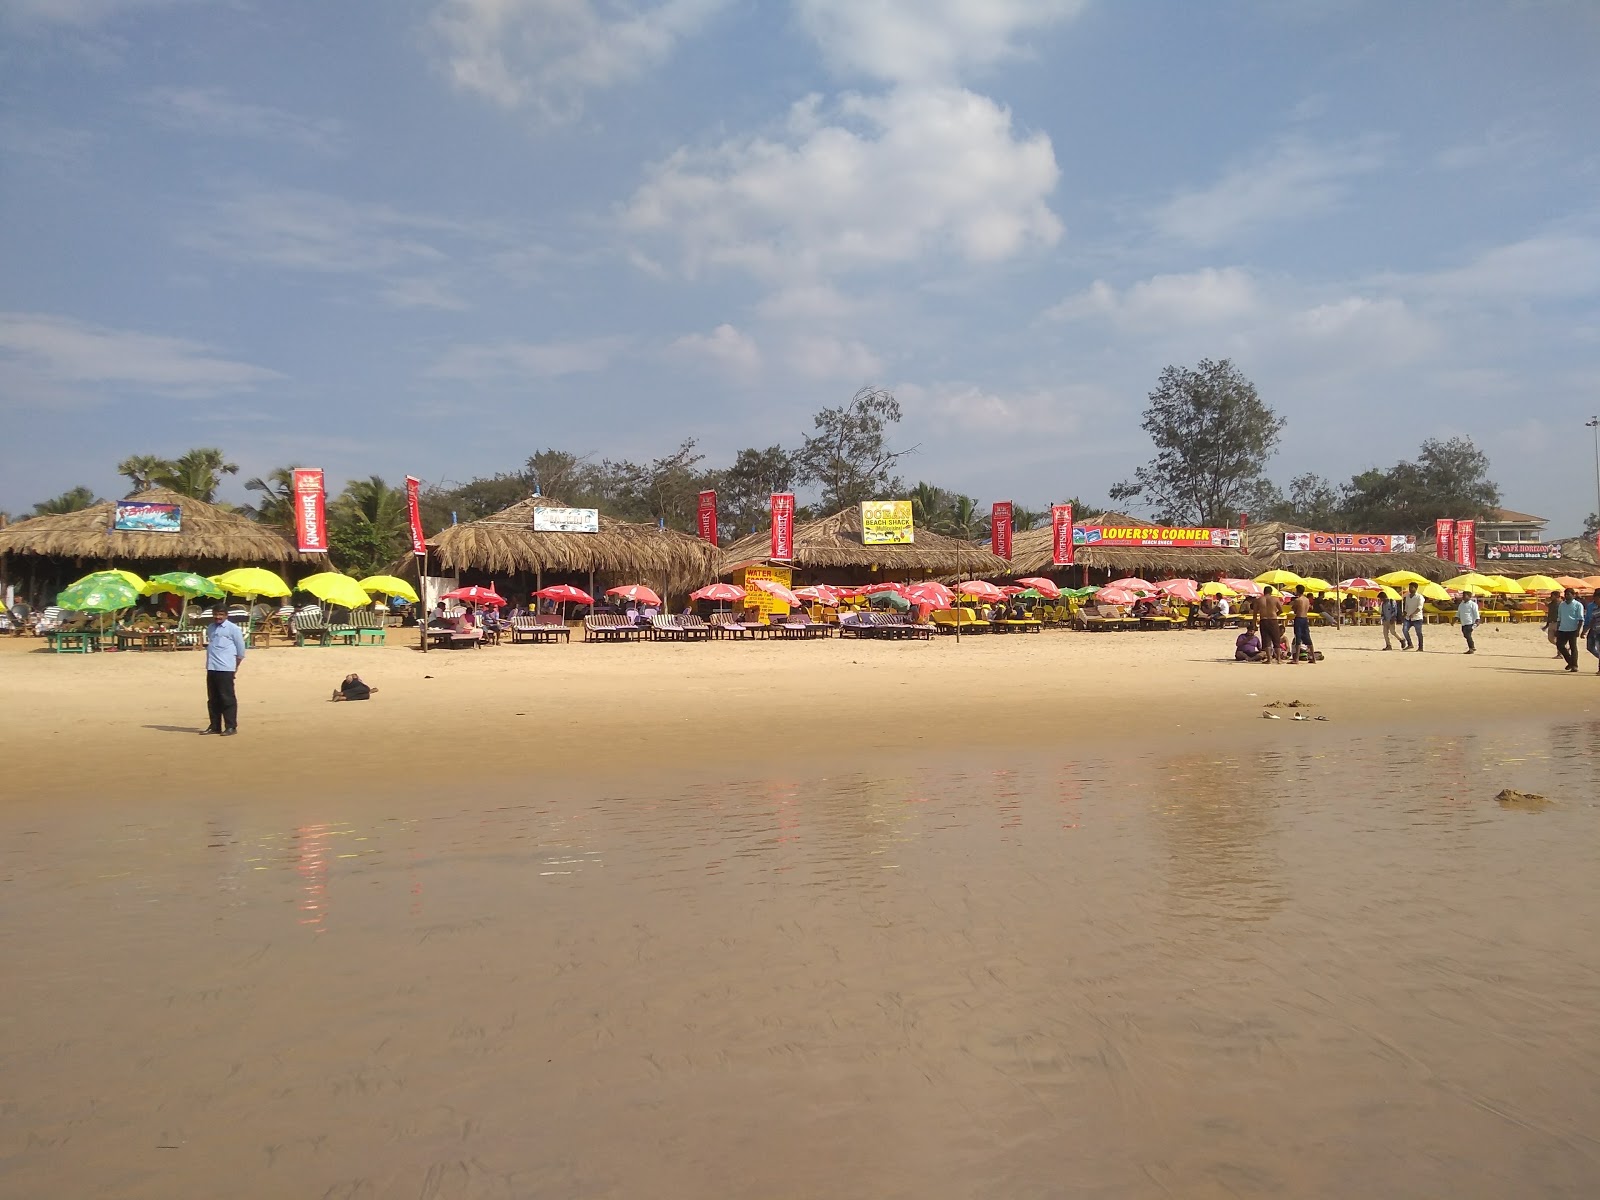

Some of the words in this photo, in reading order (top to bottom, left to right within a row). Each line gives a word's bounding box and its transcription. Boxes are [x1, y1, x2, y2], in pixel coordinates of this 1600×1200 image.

[302, 494, 319, 547] KINGFISHER
[702, 511, 711, 542] GFISHER
[864, 509, 911, 519] OCEAN
[777, 512, 789, 557] KINGFISHER
[1059, 522, 1069, 562] KINGFISHER
[1102, 528, 1160, 541] LOVERS'S
[1161, 528, 1210, 541] CORNER
[1441, 534, 1449, 560] NGFISHER
[748, 569, 772, 578] WATER
